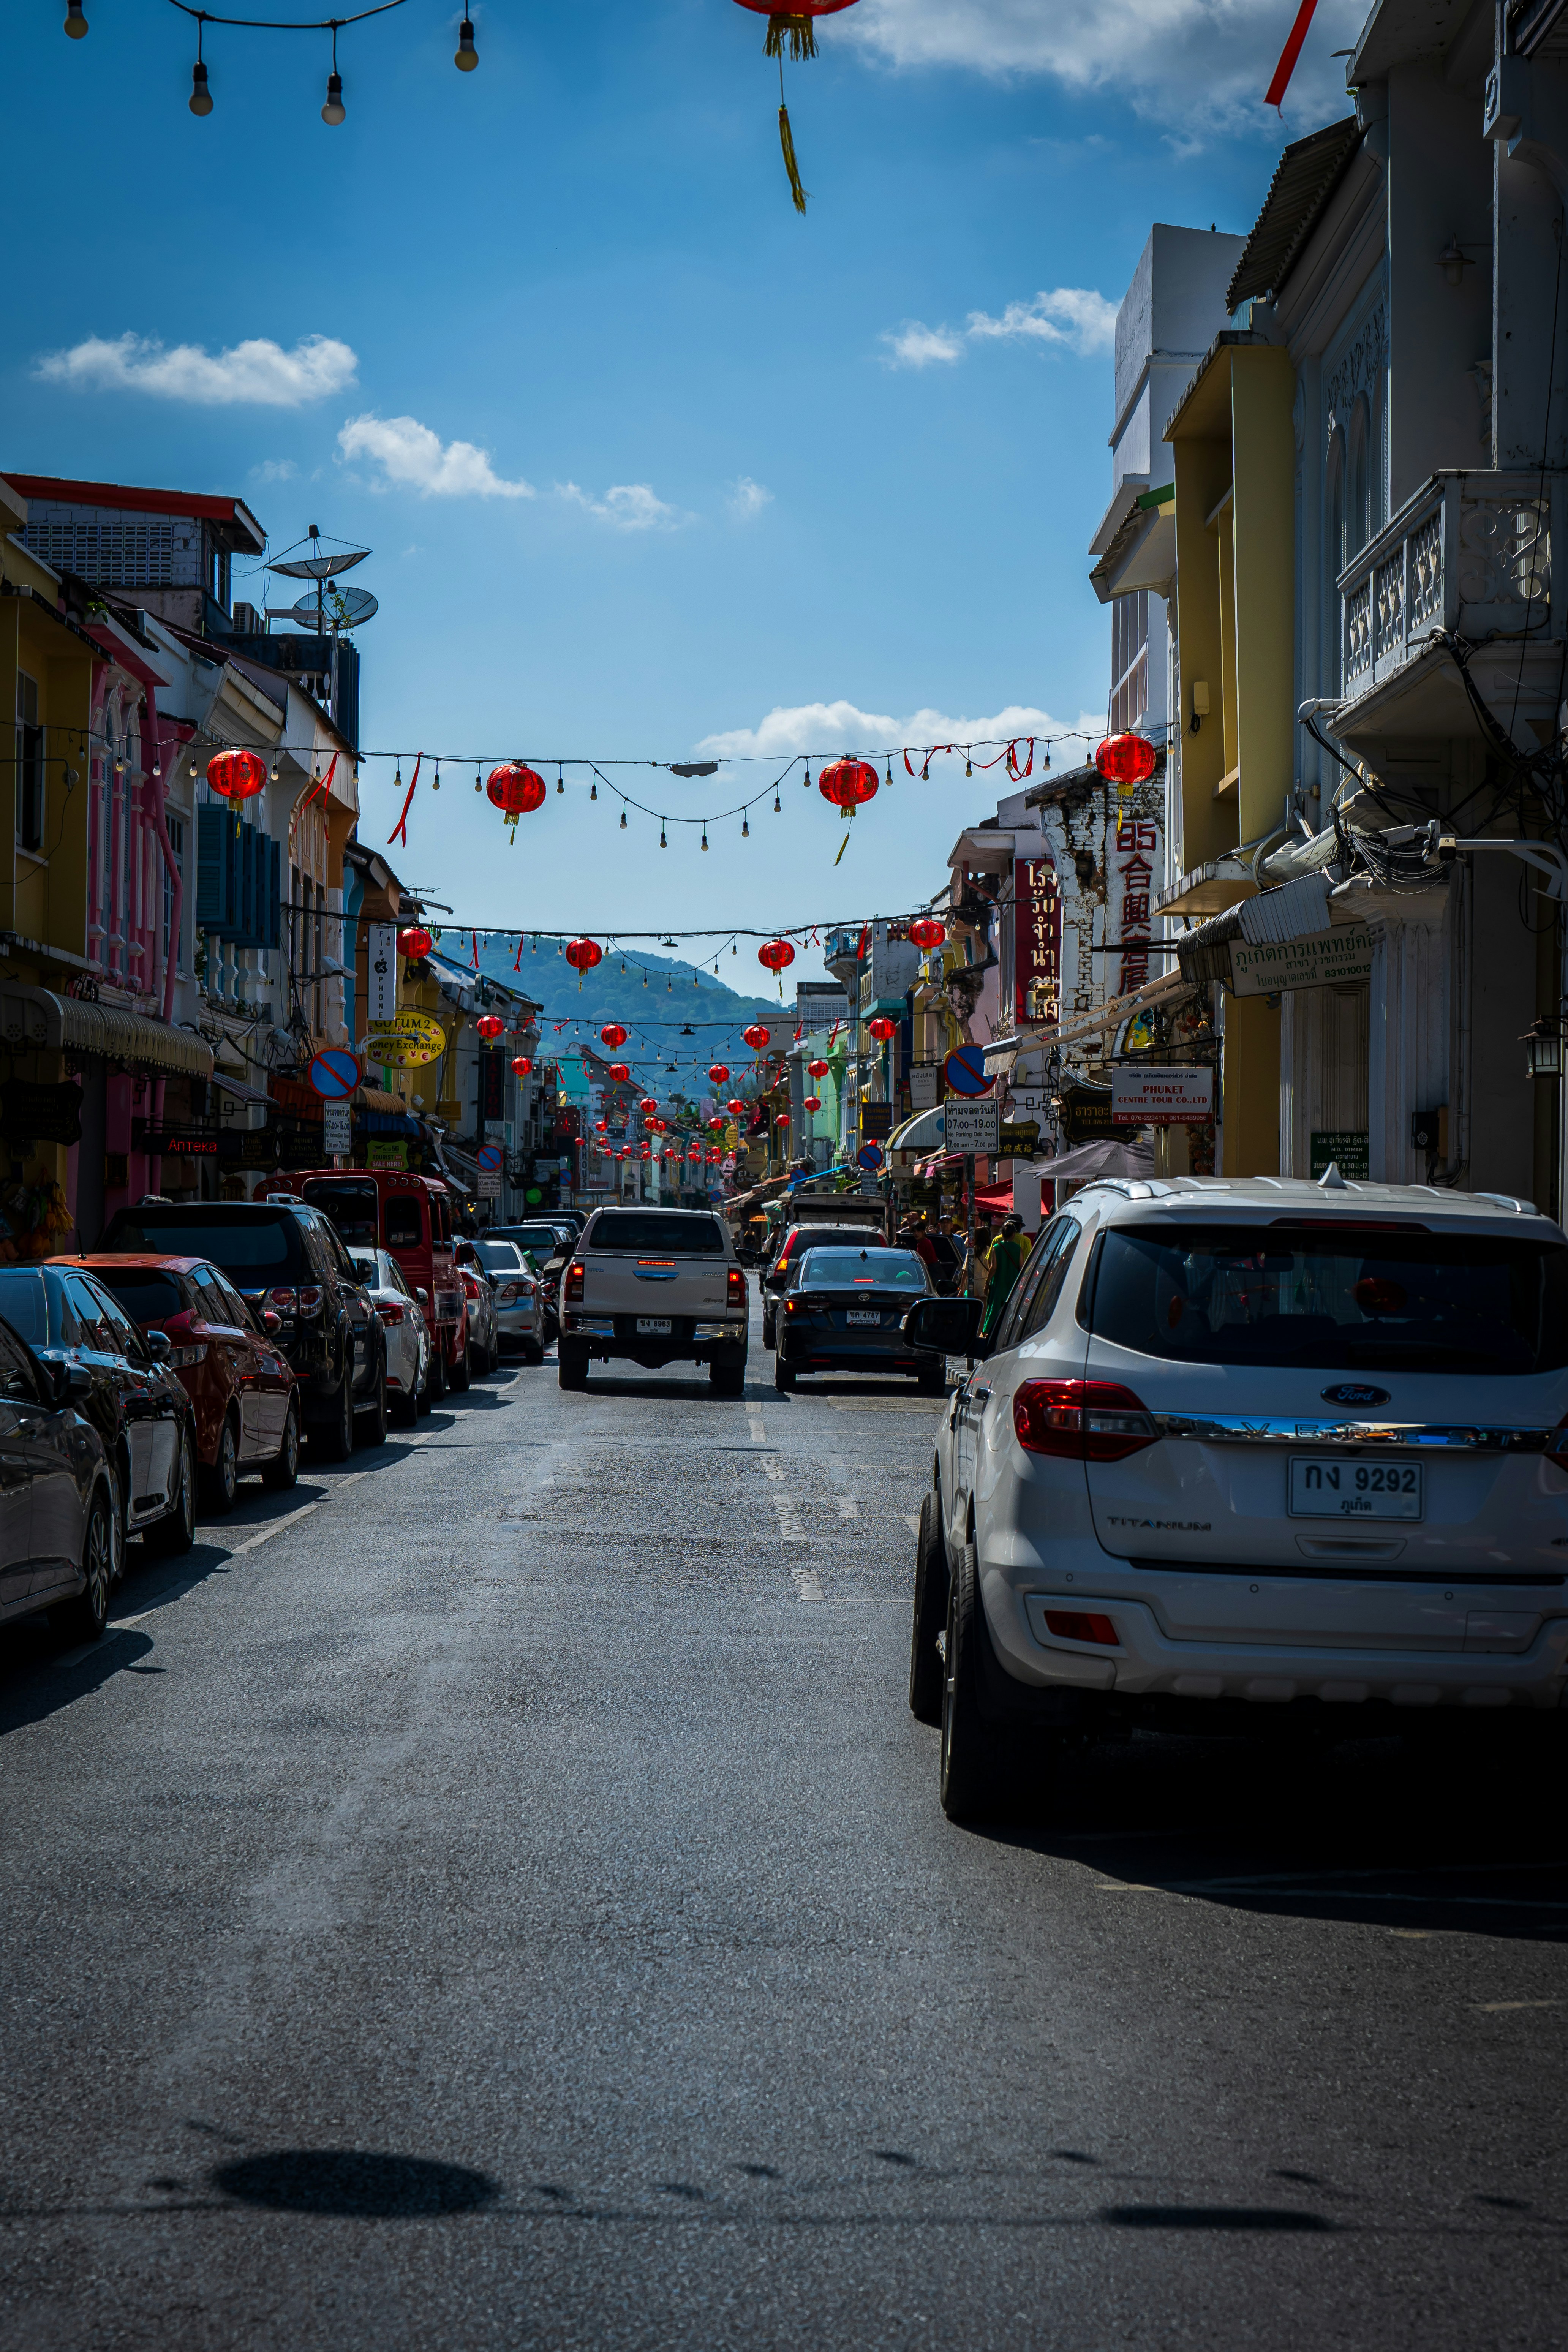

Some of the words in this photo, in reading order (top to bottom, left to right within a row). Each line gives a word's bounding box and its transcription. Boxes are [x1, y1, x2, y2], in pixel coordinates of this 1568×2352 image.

[1285, 959, 1309, 970] สาขา
[1314, 953, 1356, 966] เวชกรรม
[1256, 965, 1317, 988] ใบอนุญาตเลขที่
[424, 1019, 431, 1029] 2
[397, 1040, 442, 1053] Exchange
[487, 1051, 499, 1117] TATTOO
[1143, 1085, 1185, 1094] PHUKET
[947, 1101, 996, 1116] ห้ามจอดวันคี่
[168, 1138, 217, 1152] Аптека
[1337, 1386, 1375, 1402] Ford
[1193, 1419, 1511, 1447] EVEREST
[1305, 1465, 1340, 1491] กง
[1355, 1468, 1416, 1494] 9292
[1340, 1496, 1372, 1514] ภูเก็ต
[1107, 1516, 1212, 1532] TITANIUM
